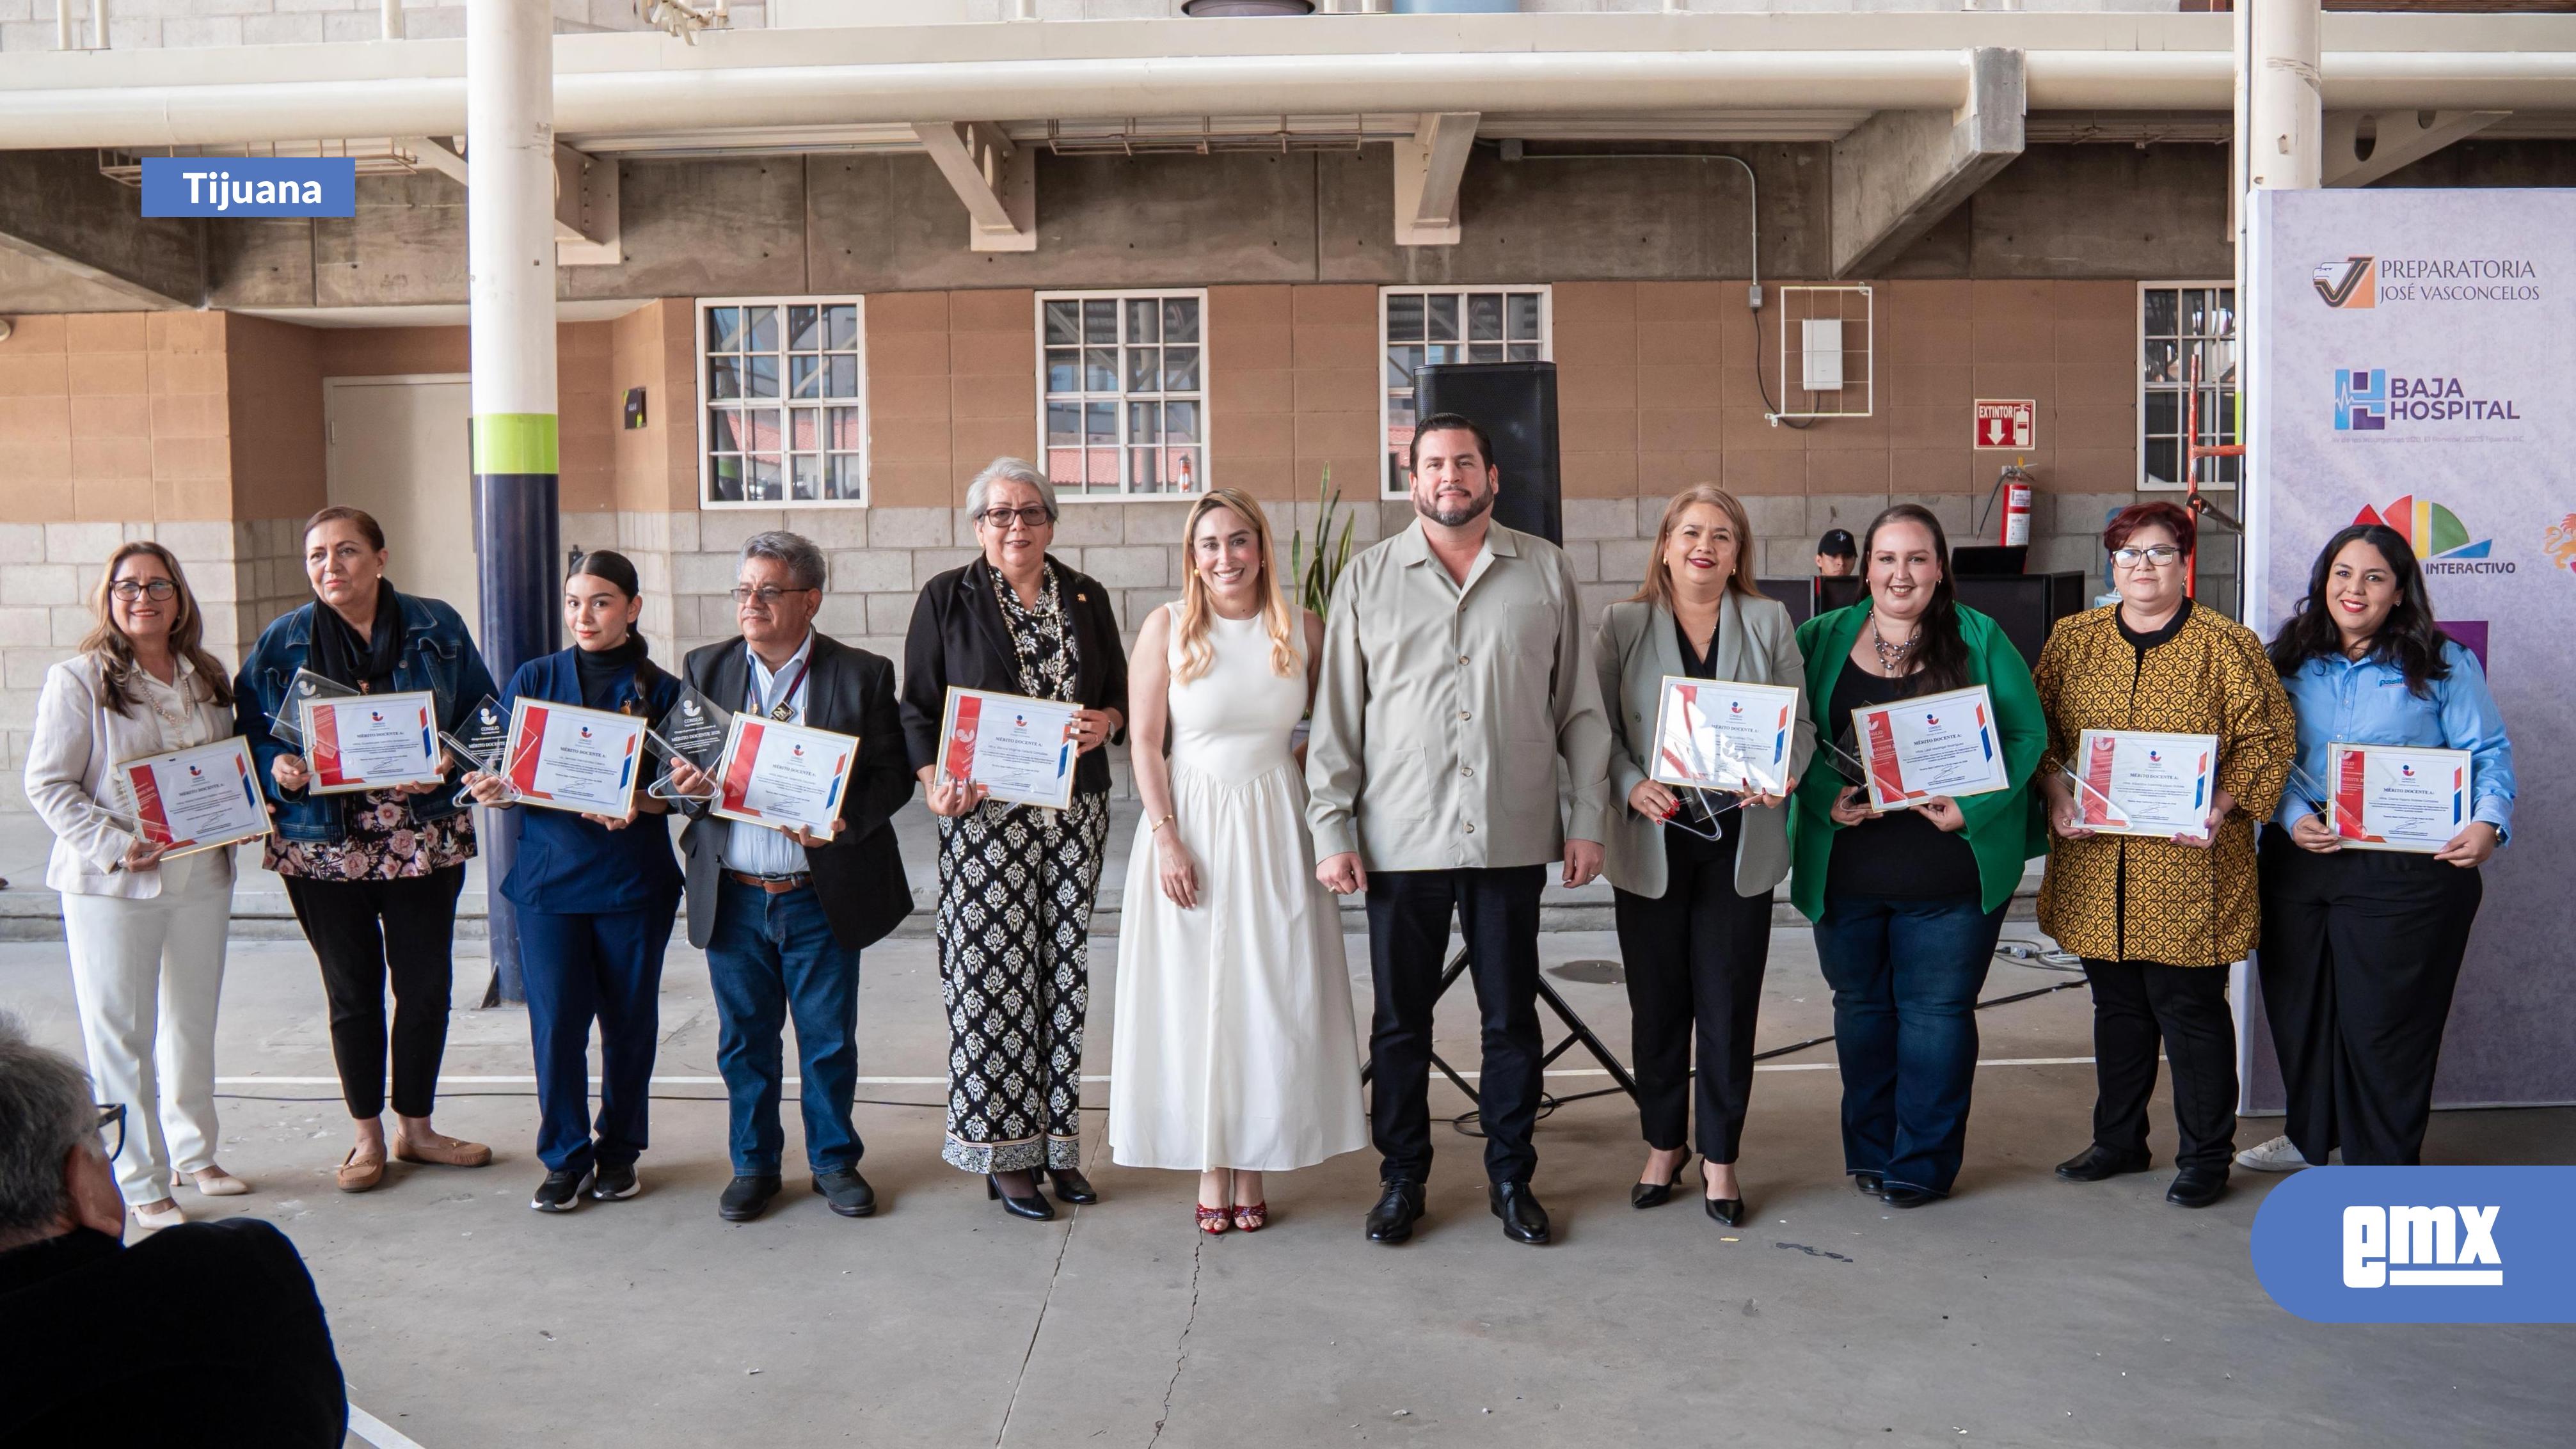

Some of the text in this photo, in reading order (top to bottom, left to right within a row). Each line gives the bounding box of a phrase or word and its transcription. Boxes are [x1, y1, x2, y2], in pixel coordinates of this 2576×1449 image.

[2381, 260, 2536, 279] PREPARATORIA
[2380, 283, 2540, 305] JOSÉ VASCONCELOS
[2390, 378, 2465, 399] BAJA
[1979, 406, 2014, 419] EXTINTOR
[2390, 400, 2520, 420] HOSPITAL
[2425, 562, 2516, 574] INTERACTIVO
[1914, 738, 1933, 746] MÉRITO
